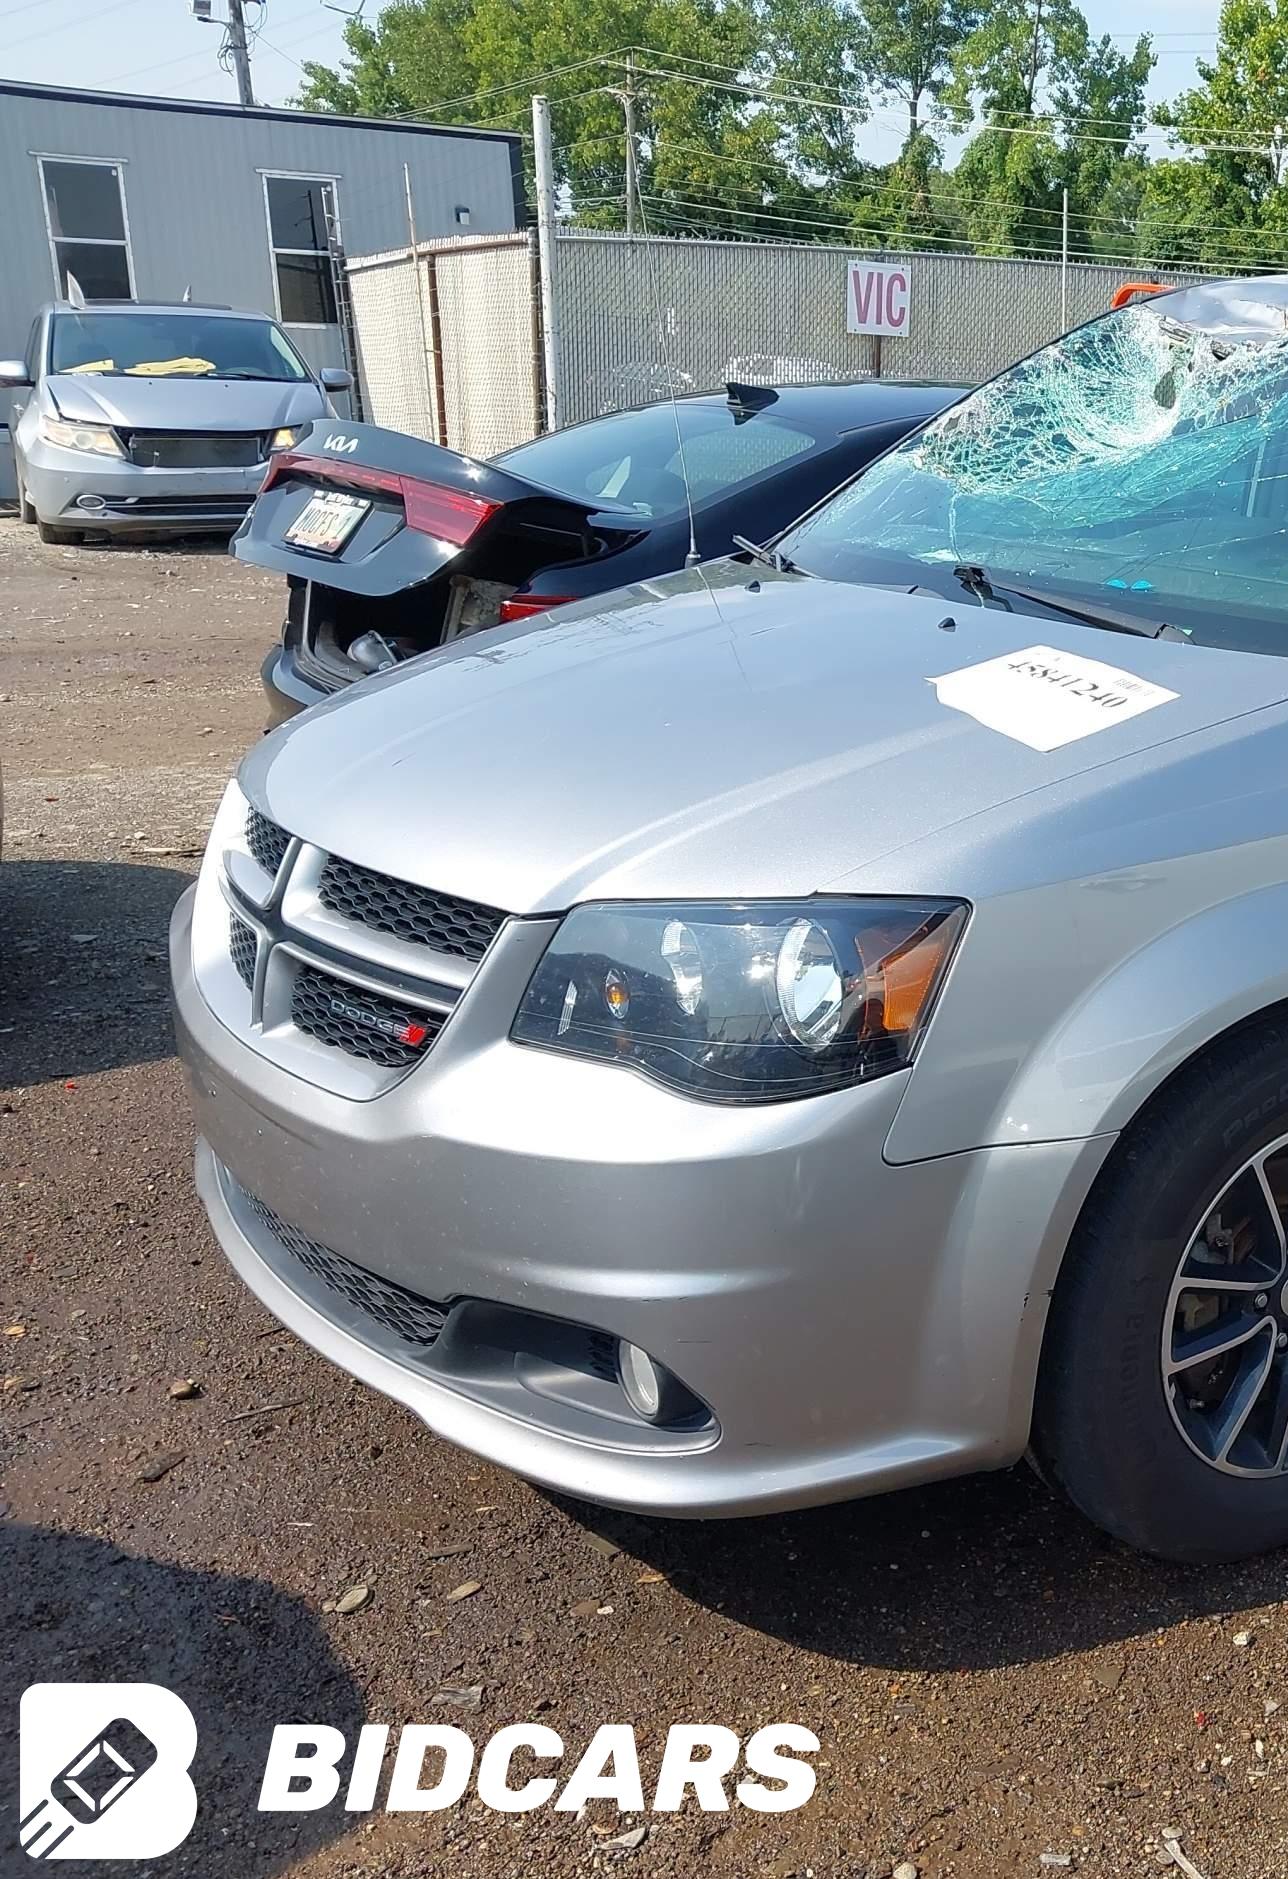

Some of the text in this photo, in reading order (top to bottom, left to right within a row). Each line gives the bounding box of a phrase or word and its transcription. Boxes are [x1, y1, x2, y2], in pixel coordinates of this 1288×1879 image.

[852, 270, 907, 328] VIC
[323, 434, 359, 453] KIA
[331, 999, 410, 1039] DODGE
